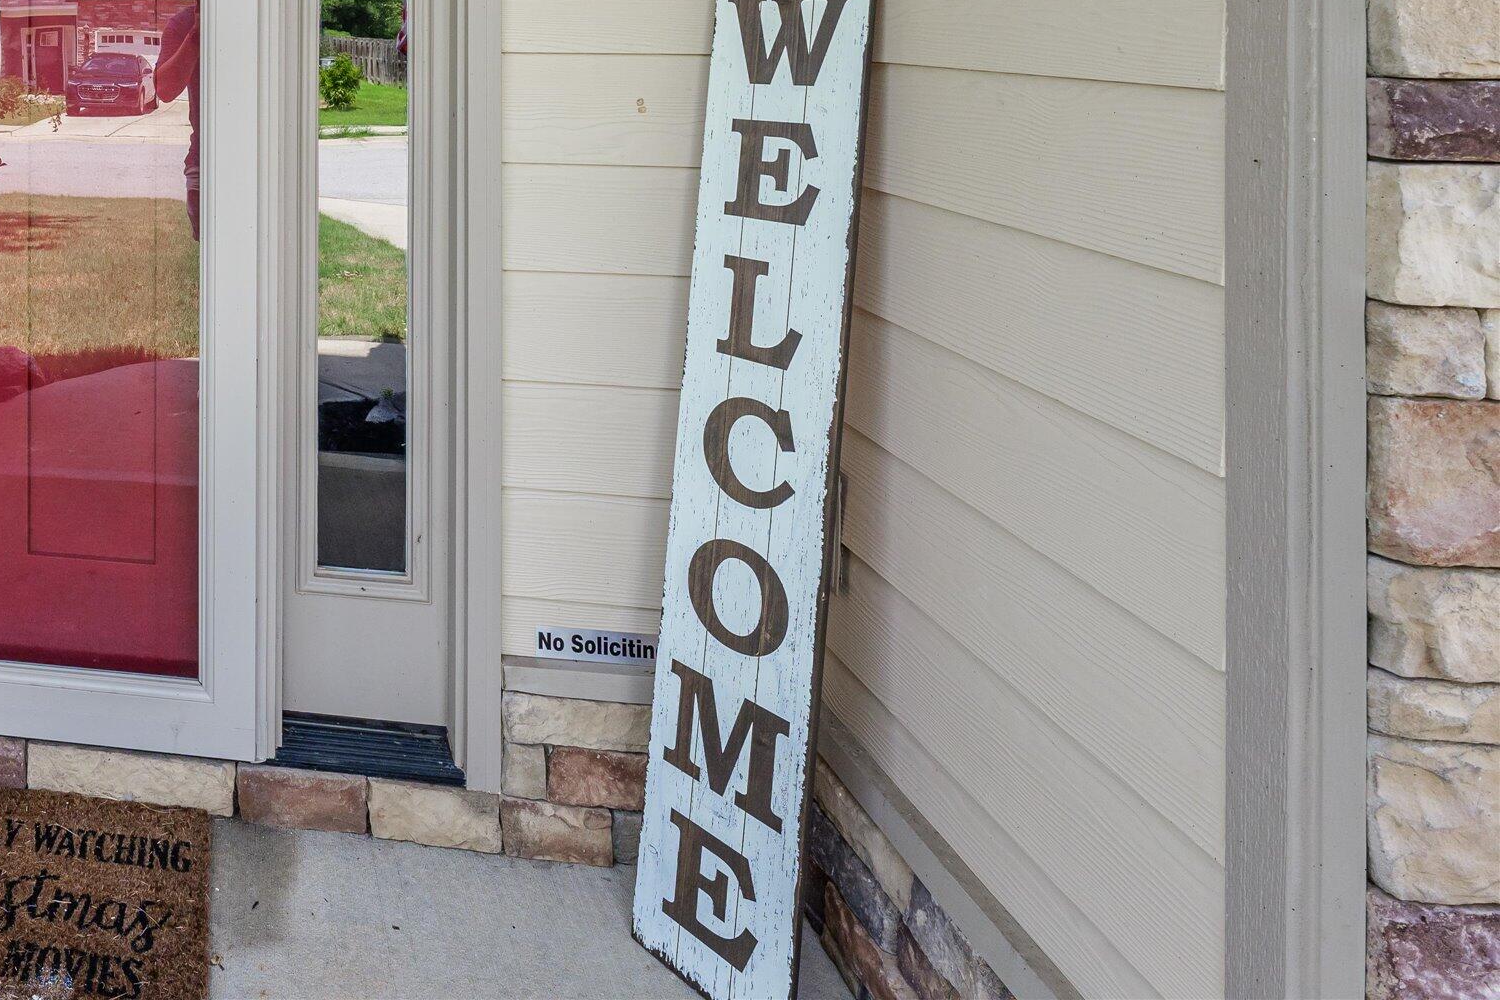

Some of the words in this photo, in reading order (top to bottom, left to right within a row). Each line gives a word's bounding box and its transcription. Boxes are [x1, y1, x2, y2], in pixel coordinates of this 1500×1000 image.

[538, 632, 565, 651] No
[571, 634, 658, 659] Solicitin
[33, 822, 192, 872] WATCHING
[0, 939, 145, 999] MOVIES
